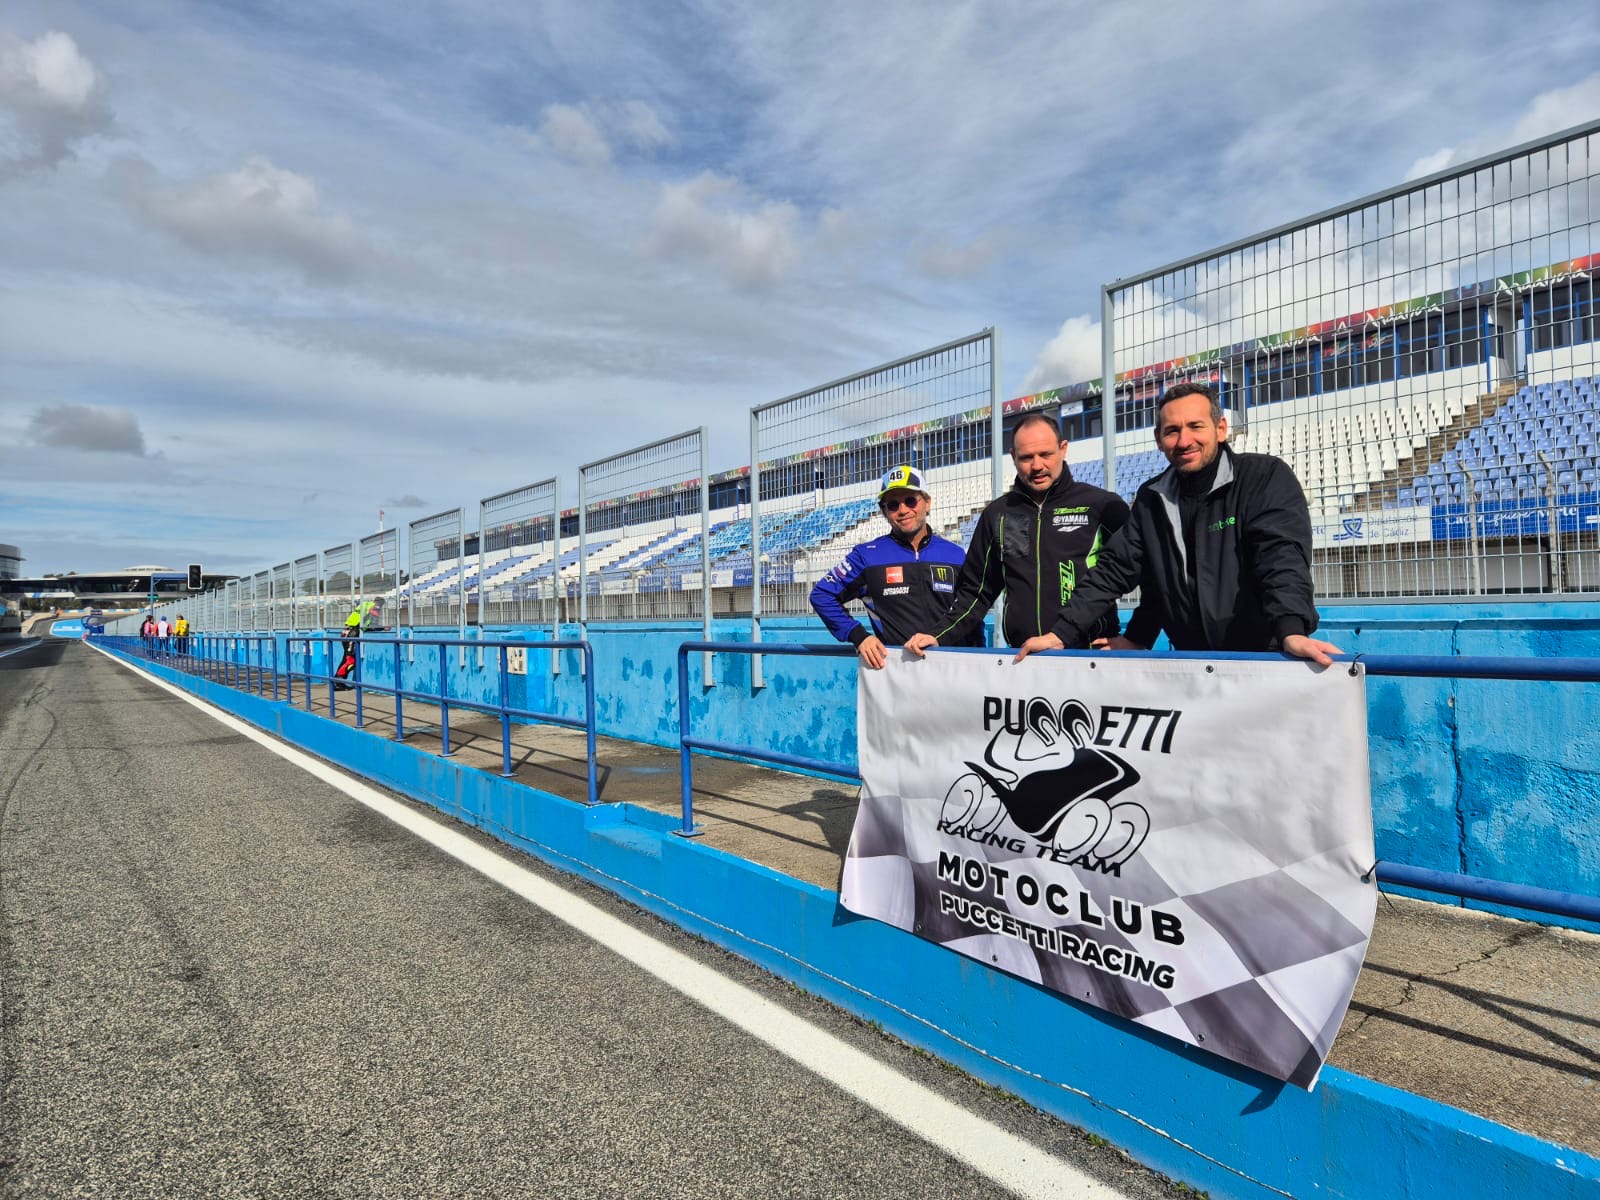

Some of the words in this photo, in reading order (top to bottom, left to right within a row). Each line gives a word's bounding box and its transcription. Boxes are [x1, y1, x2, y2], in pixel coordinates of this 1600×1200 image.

[1363, 297, 1443, 328] Andalucía
[1020, 391, 1062, 411] Andalucía
[889, 470, 903, 481] 46
[1061, 514, 1089, 523] YAMAHA
[936, 820, 1027, 855] RACING
[1035, 842, 1122, 878] TEAM
[937, 851, 1186, 947] MOTOCLUB
[940, 892, 1056, 952] PUCCETTI
[1061, 933, 1176, 990] RACING
